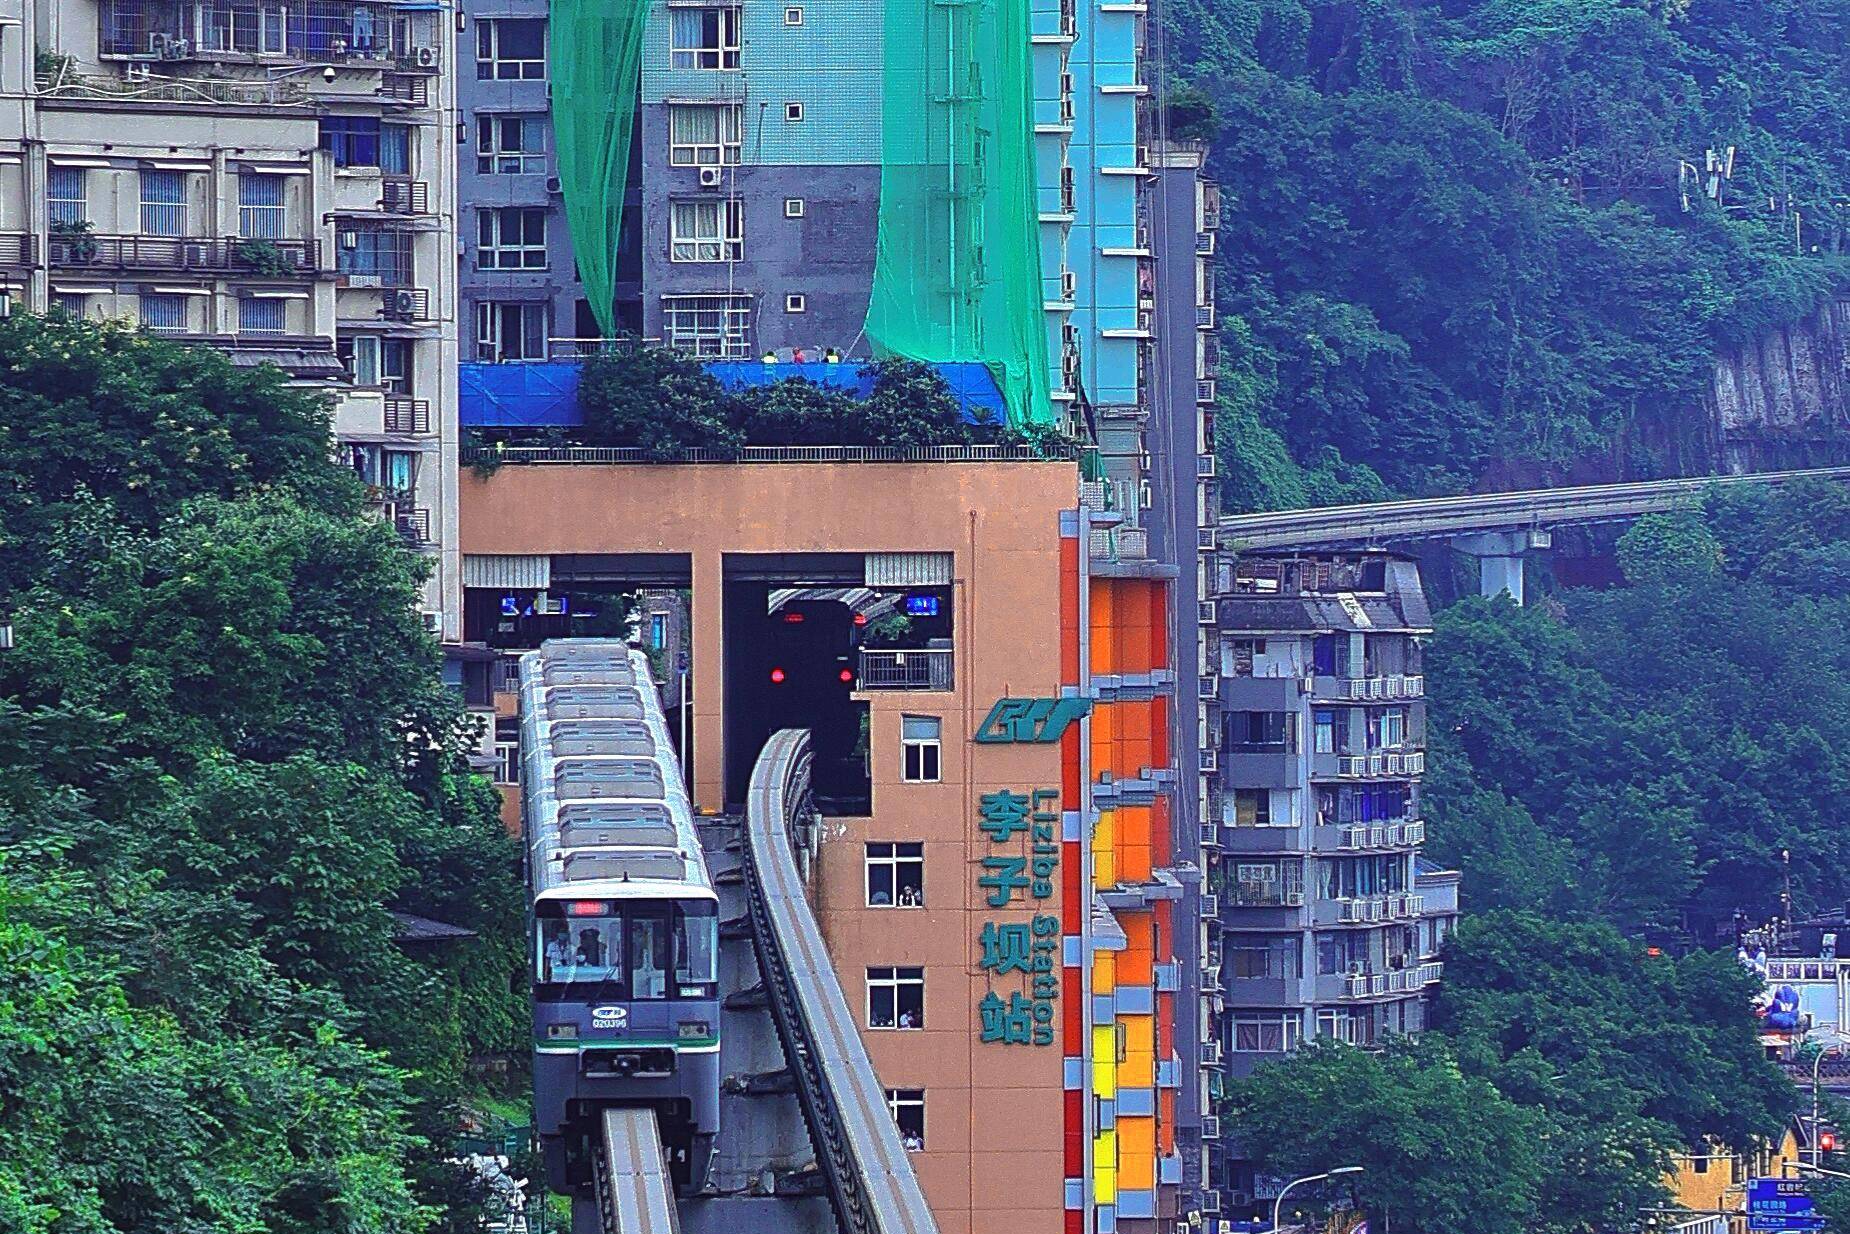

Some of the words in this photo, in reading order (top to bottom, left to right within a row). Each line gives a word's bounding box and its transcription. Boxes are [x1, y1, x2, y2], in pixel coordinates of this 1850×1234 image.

[1031, 788, 1060, 899] Liziba
[979, 788, 1032, 1046] 李子坝站
[1031, 915, 1060, 1047] Station
